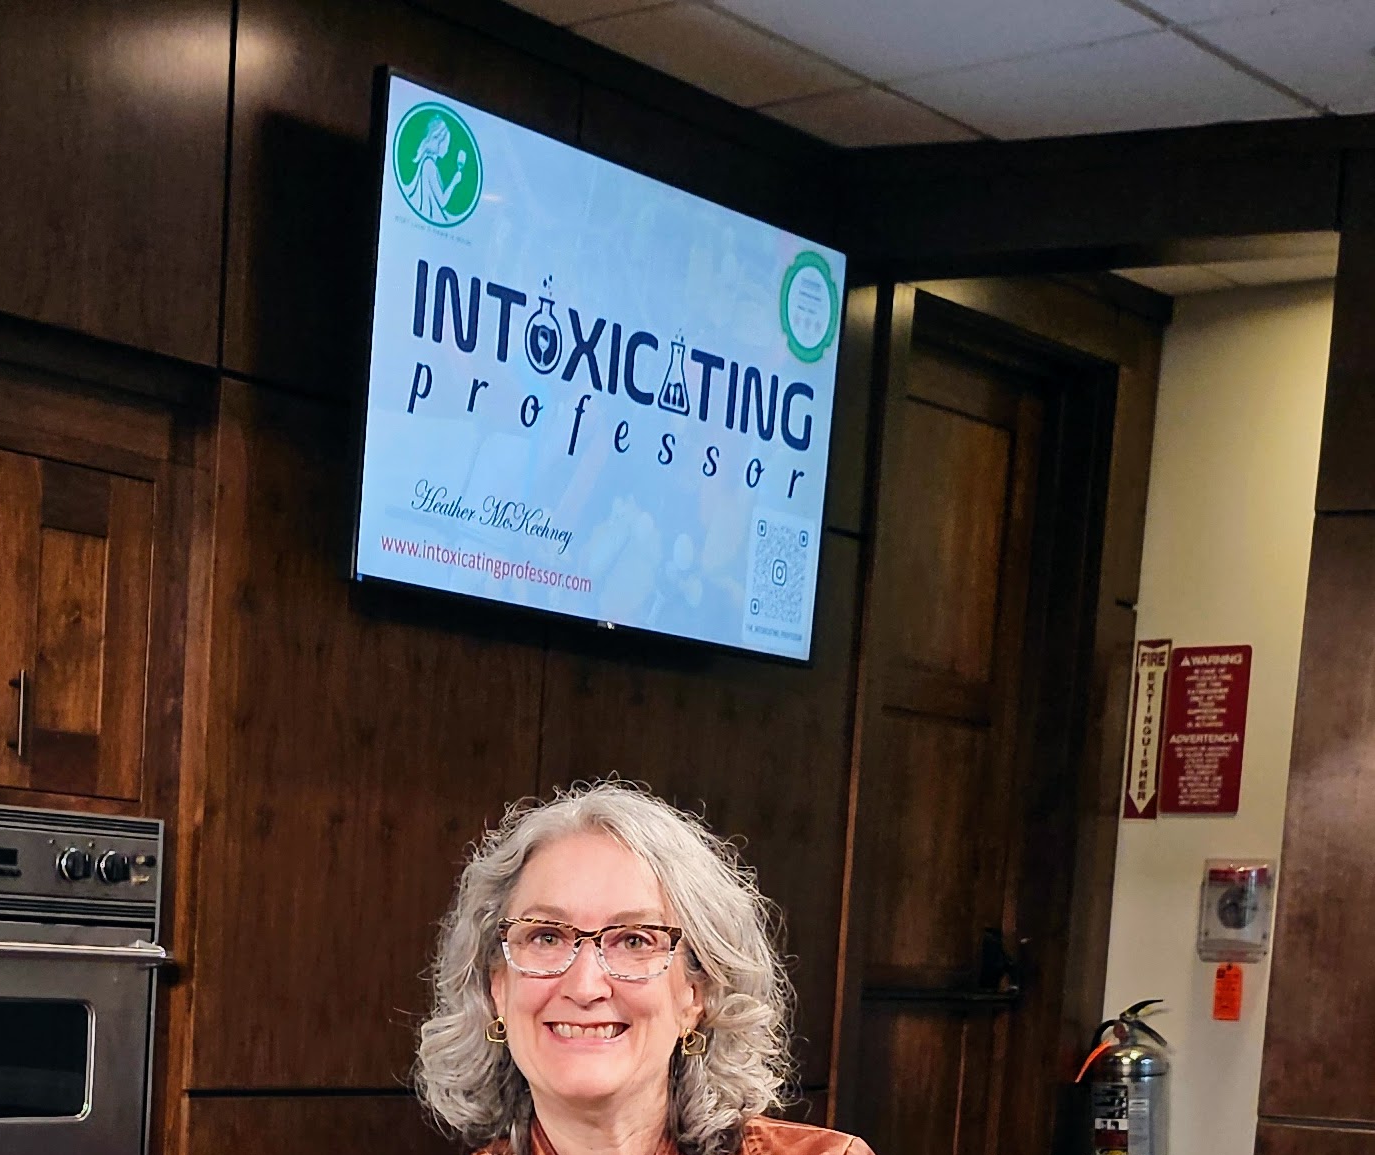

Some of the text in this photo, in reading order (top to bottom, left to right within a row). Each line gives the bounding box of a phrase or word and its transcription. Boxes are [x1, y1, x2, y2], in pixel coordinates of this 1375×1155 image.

[412, 258, 814, 452] INTOXICATING
[407, 361, 805, 499] professor
[411, 479, 574, 555] Heather McKechney
[381, 535, 592, 593] www.intoxicatingprofessor.com
[1140, 651, 1166, 667] FIRE
[1190, 653, 1243, 665] WARNING
[1137, 671, 1156, 800] EXTINGUISHER
[1169, 732, 1239, 744] ADVERTENCIA
